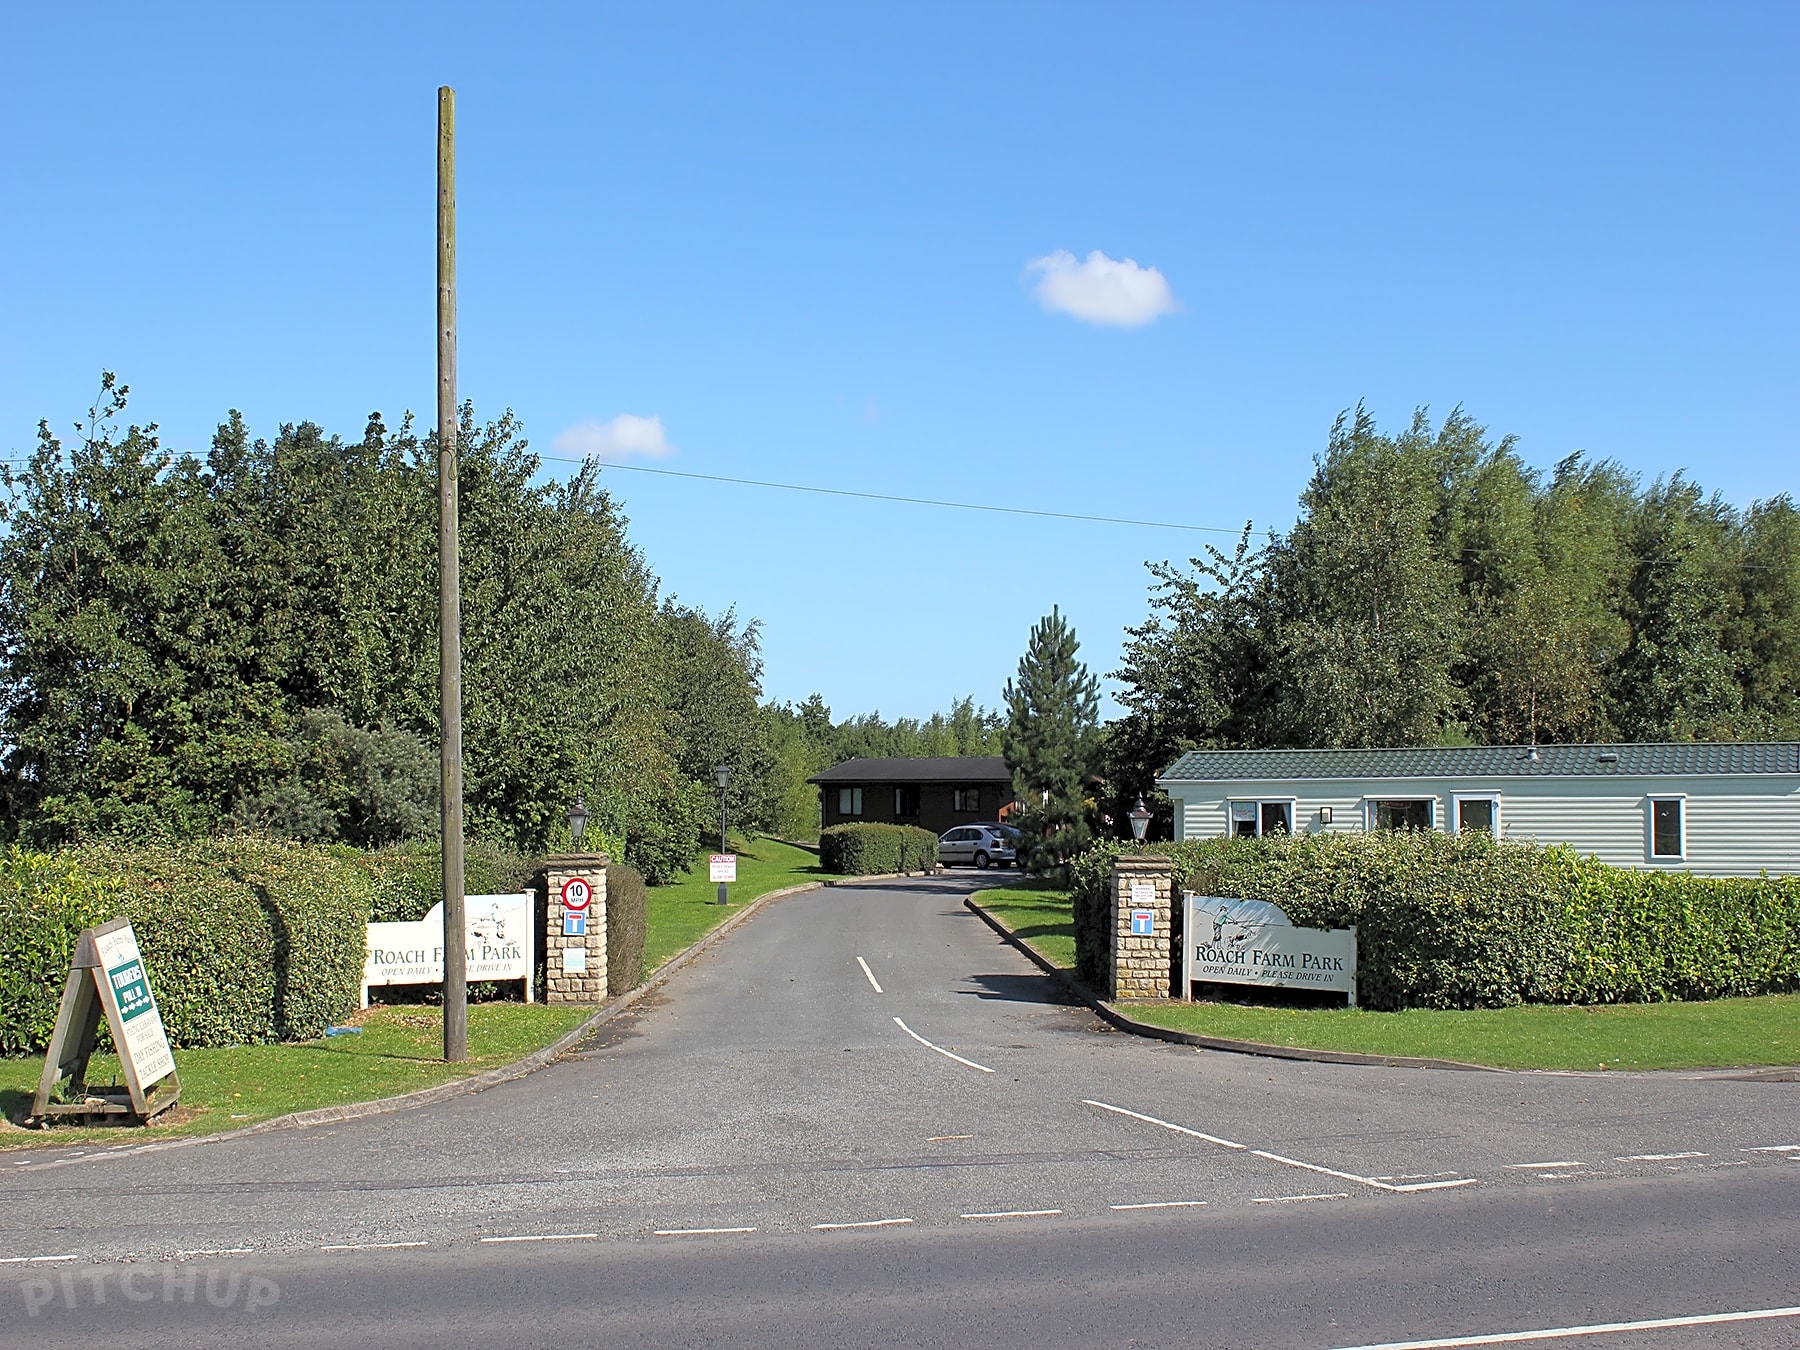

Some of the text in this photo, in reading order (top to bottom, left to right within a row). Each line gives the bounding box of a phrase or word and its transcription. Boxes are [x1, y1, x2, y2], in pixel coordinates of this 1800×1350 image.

[711, 855, 736, 863] CAUTION
[569, 884, 583, 897] 10
[373, 949, 425, 965] ROACH
[482, 945, 521, 960] PARK
[1195, 945, 1344, 971] ROACH FARM PARK
[111, 964, 143, 990] TOURERS
[381, 967, 406, 976] OPEN
[406, 966, 433, 976] DAILY
[476, 963, 501, 973] DRIVE
[502, 963, 513, 971] IN
[1202, 965, 1334, 982] OPEN DAILY PLEASE DRIVE IN
[122, 988, 138, 1004] PULL
[133, 1037, 166, 1064] DAY FISHING
[139, 1053, 170, 1080] TACKLE SHOP
